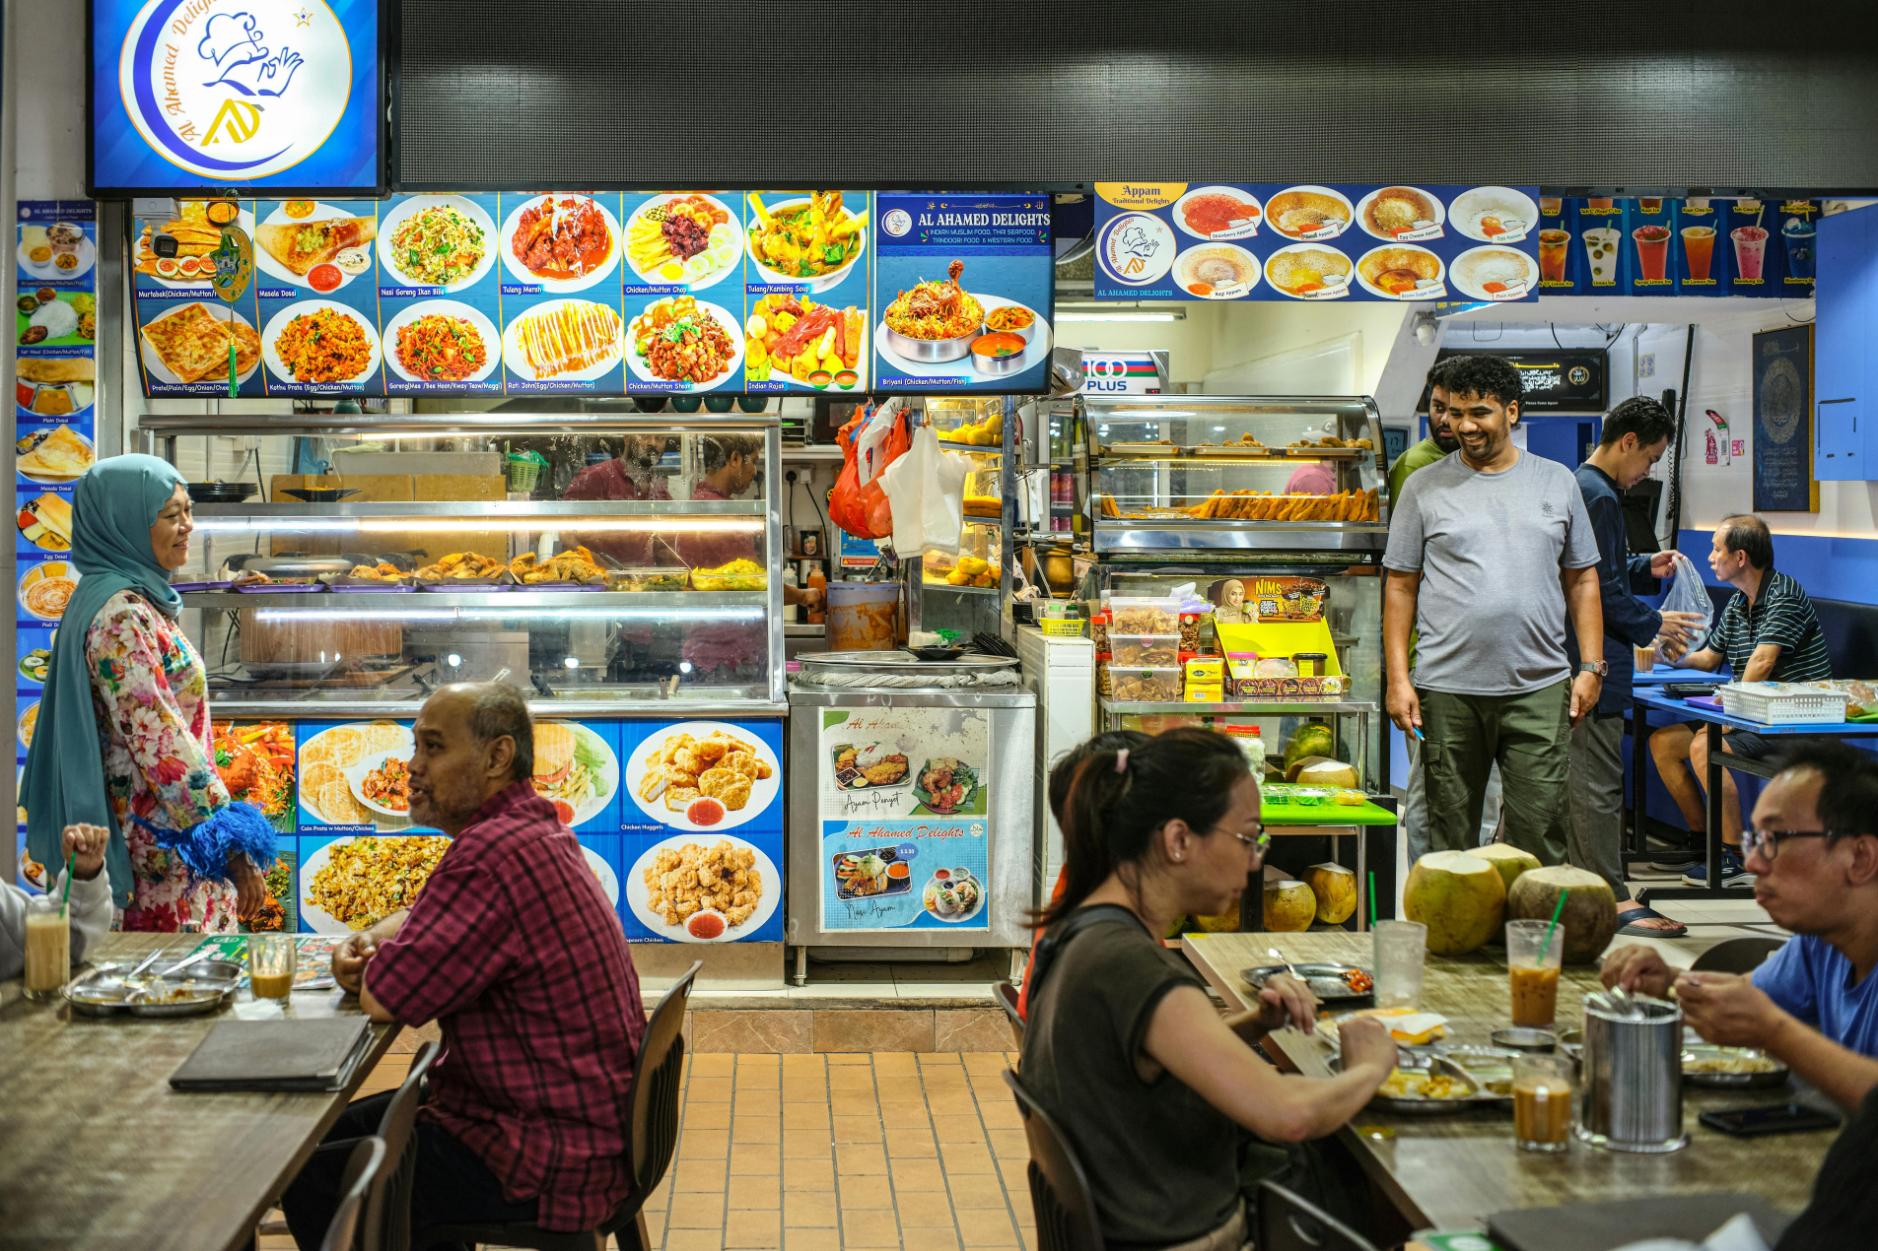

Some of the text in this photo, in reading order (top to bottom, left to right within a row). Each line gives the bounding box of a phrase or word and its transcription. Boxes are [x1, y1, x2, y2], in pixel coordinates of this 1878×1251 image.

[163, 43, 186, 117] Ahamed
[1121, 185, 1161, 198] Appam
[1146, 197, 1170, 205] Delights
[918, 213, 1051, 227] AL AHAMED DELIGHTS
[381, 288, 394, 296] Nasi
[395, 288, 416, 298] Goreng
[673, 286, 687, 295] Chop
[1097, 289, 1173, 297] AL AHAMED DELIGHTS
[1087, 359, 1128, 380] 100
[1087, 380, 1127, 391] PLUS
[1255, 579, 1282, 595] NIMS
[642, 824, 664, 832] Nuggets
[866, 826, 914, 839] Ahamed
[915, 825, 964, 841] Delights
